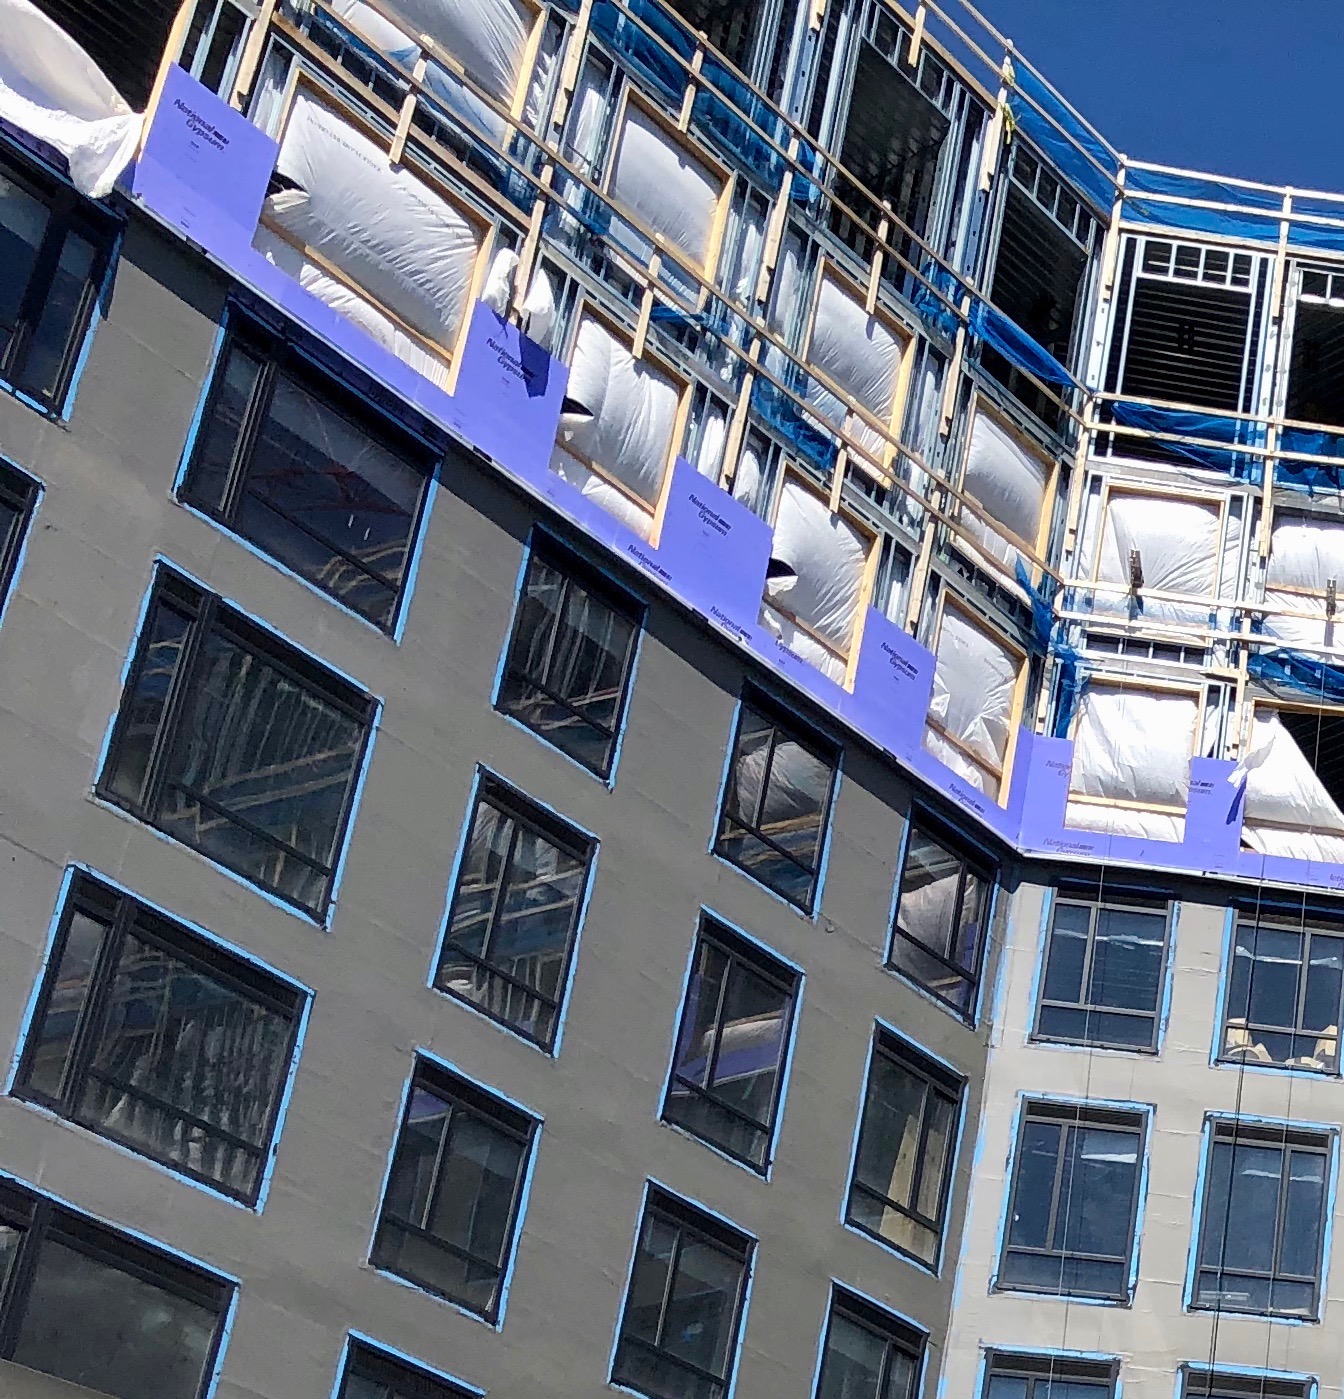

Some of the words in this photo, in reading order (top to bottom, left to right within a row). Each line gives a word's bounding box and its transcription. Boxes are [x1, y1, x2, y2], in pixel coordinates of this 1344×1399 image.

[173, 98, 215, 133] National
[186, 118, 225, 152] Gypsum
[688, 494, 721, 522] National
[627, 544, 661, 573] National
